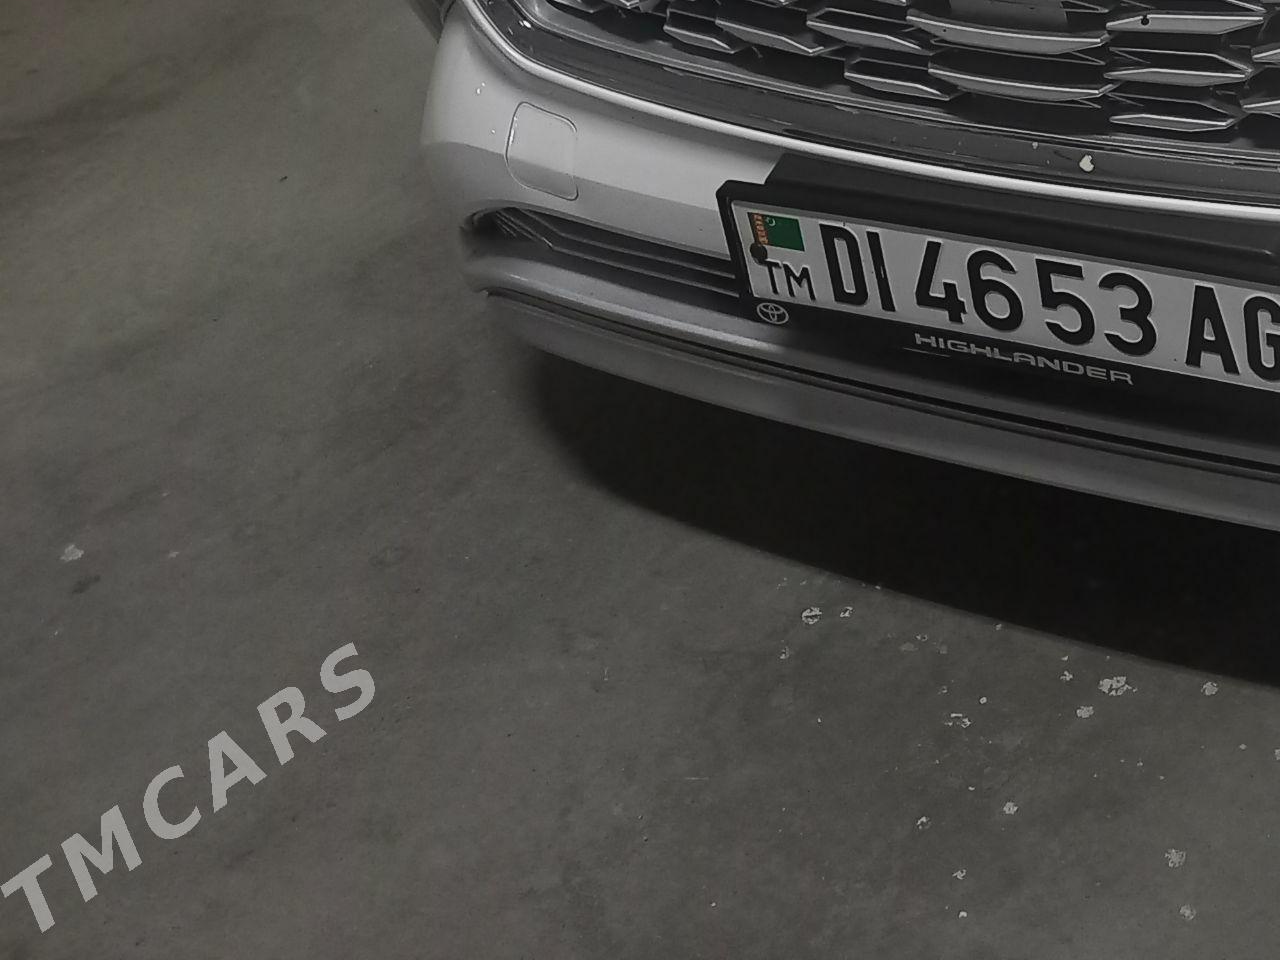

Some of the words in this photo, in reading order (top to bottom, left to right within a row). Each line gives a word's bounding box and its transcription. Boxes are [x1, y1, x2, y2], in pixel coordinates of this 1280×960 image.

[757, 259, 816, 301] TM
[914, 239, 1158, 357] 4653
[914, 332, 1135, 386] HIGHLANDER
